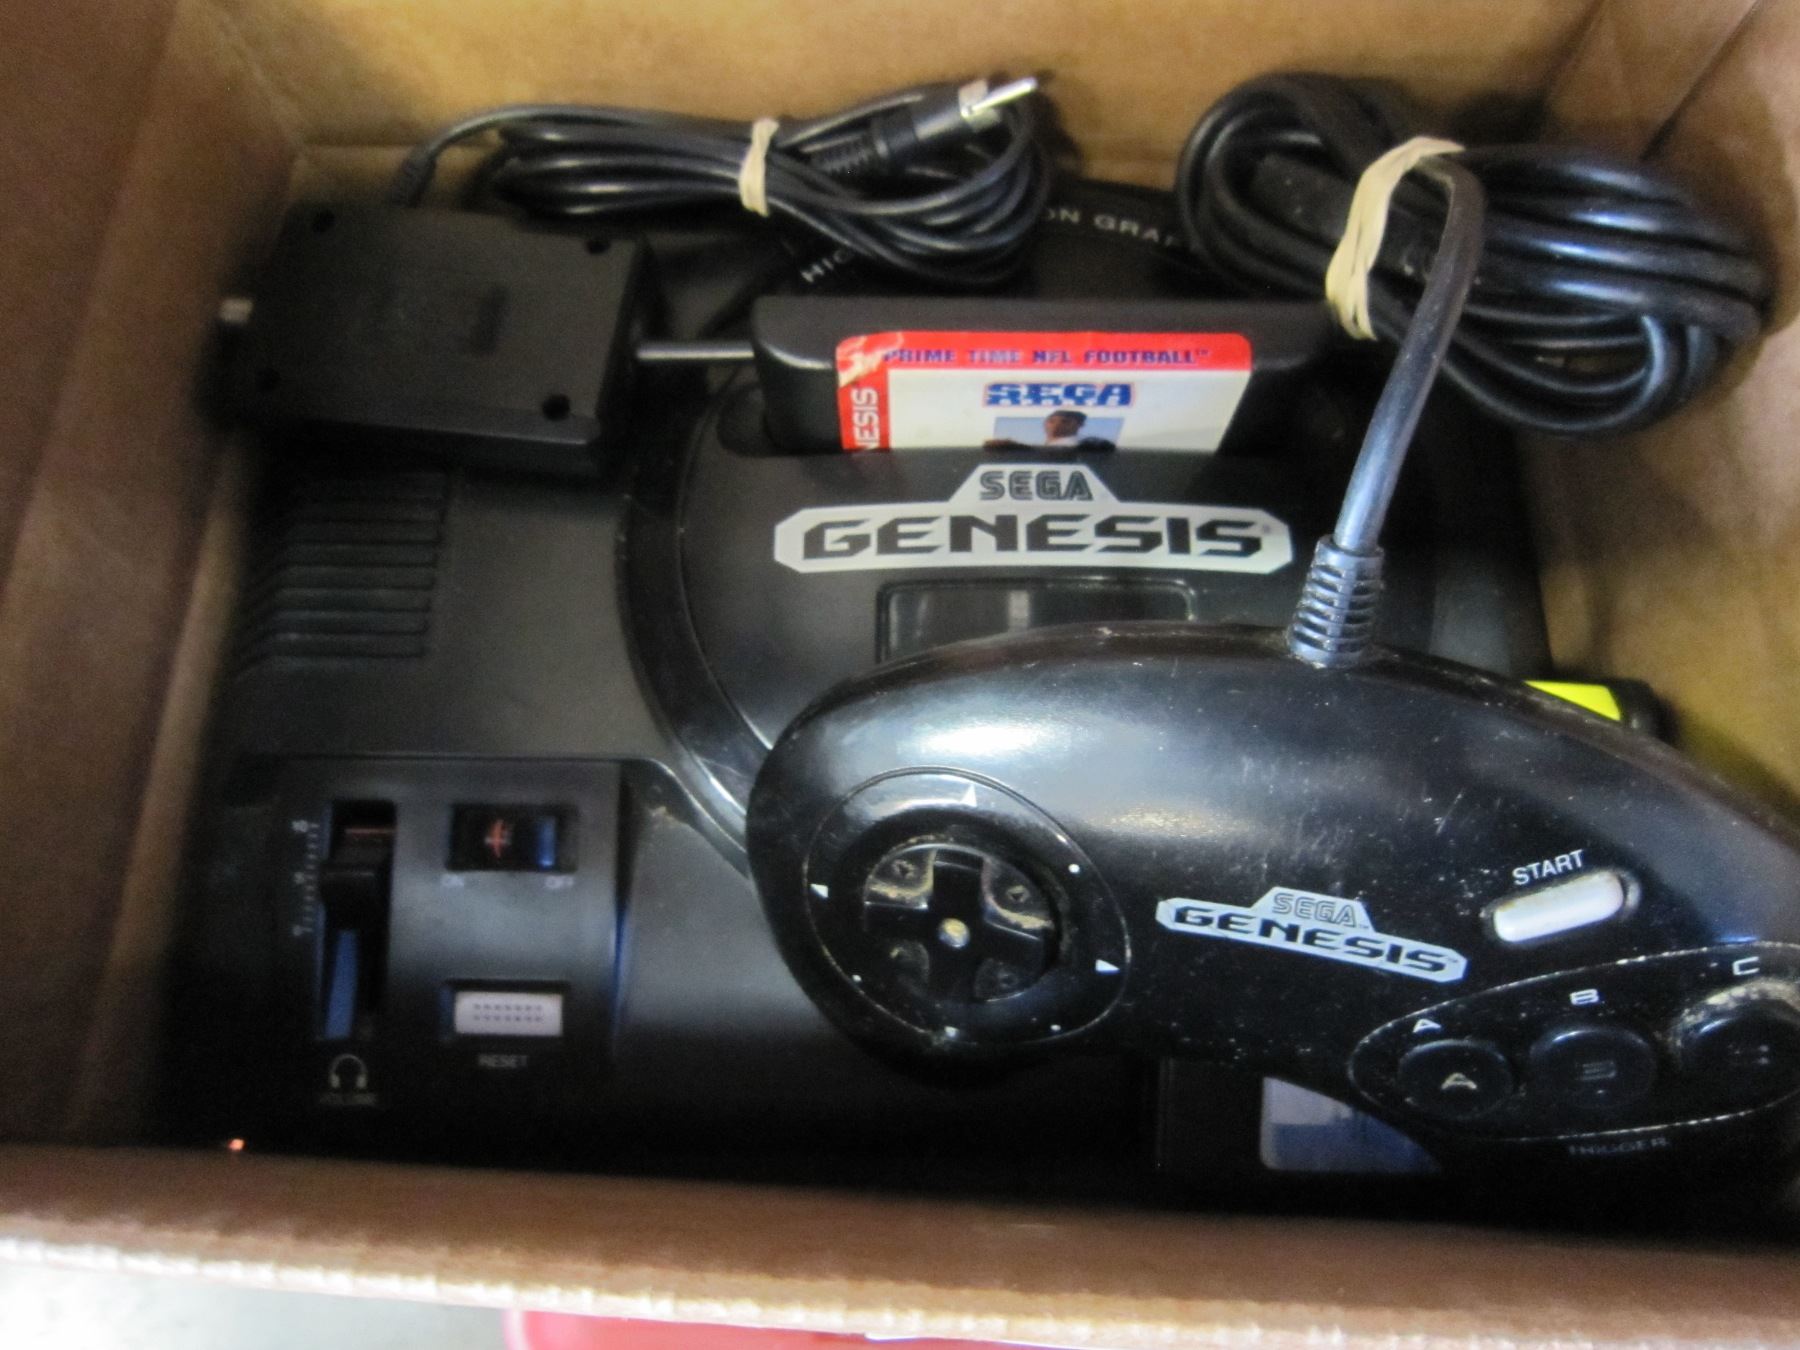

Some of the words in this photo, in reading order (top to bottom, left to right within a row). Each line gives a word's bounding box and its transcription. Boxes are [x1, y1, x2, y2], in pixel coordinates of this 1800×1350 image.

[884, 348, 954, 363] PRIME
[968, 349, 1021, 363] TIME
[1032, 350, 1071, 364] NFL
[985, 382, 1133, 406] SEGA
[979, 470, 1094, 501] SEGA
[803, 513, 1264, 561] GENESIS
[1511, 848, 1584, 887] START
[1271, 891, 1358, 929] SEGA
[1173, 905, 1455, 973] GENESIS
[1732, 956, 1760, 976] C
[1569, 988, 1599, 1006] B
[1413, 1017, 1442, 1034] A
[1440, 1071, 1478, 1091] A
